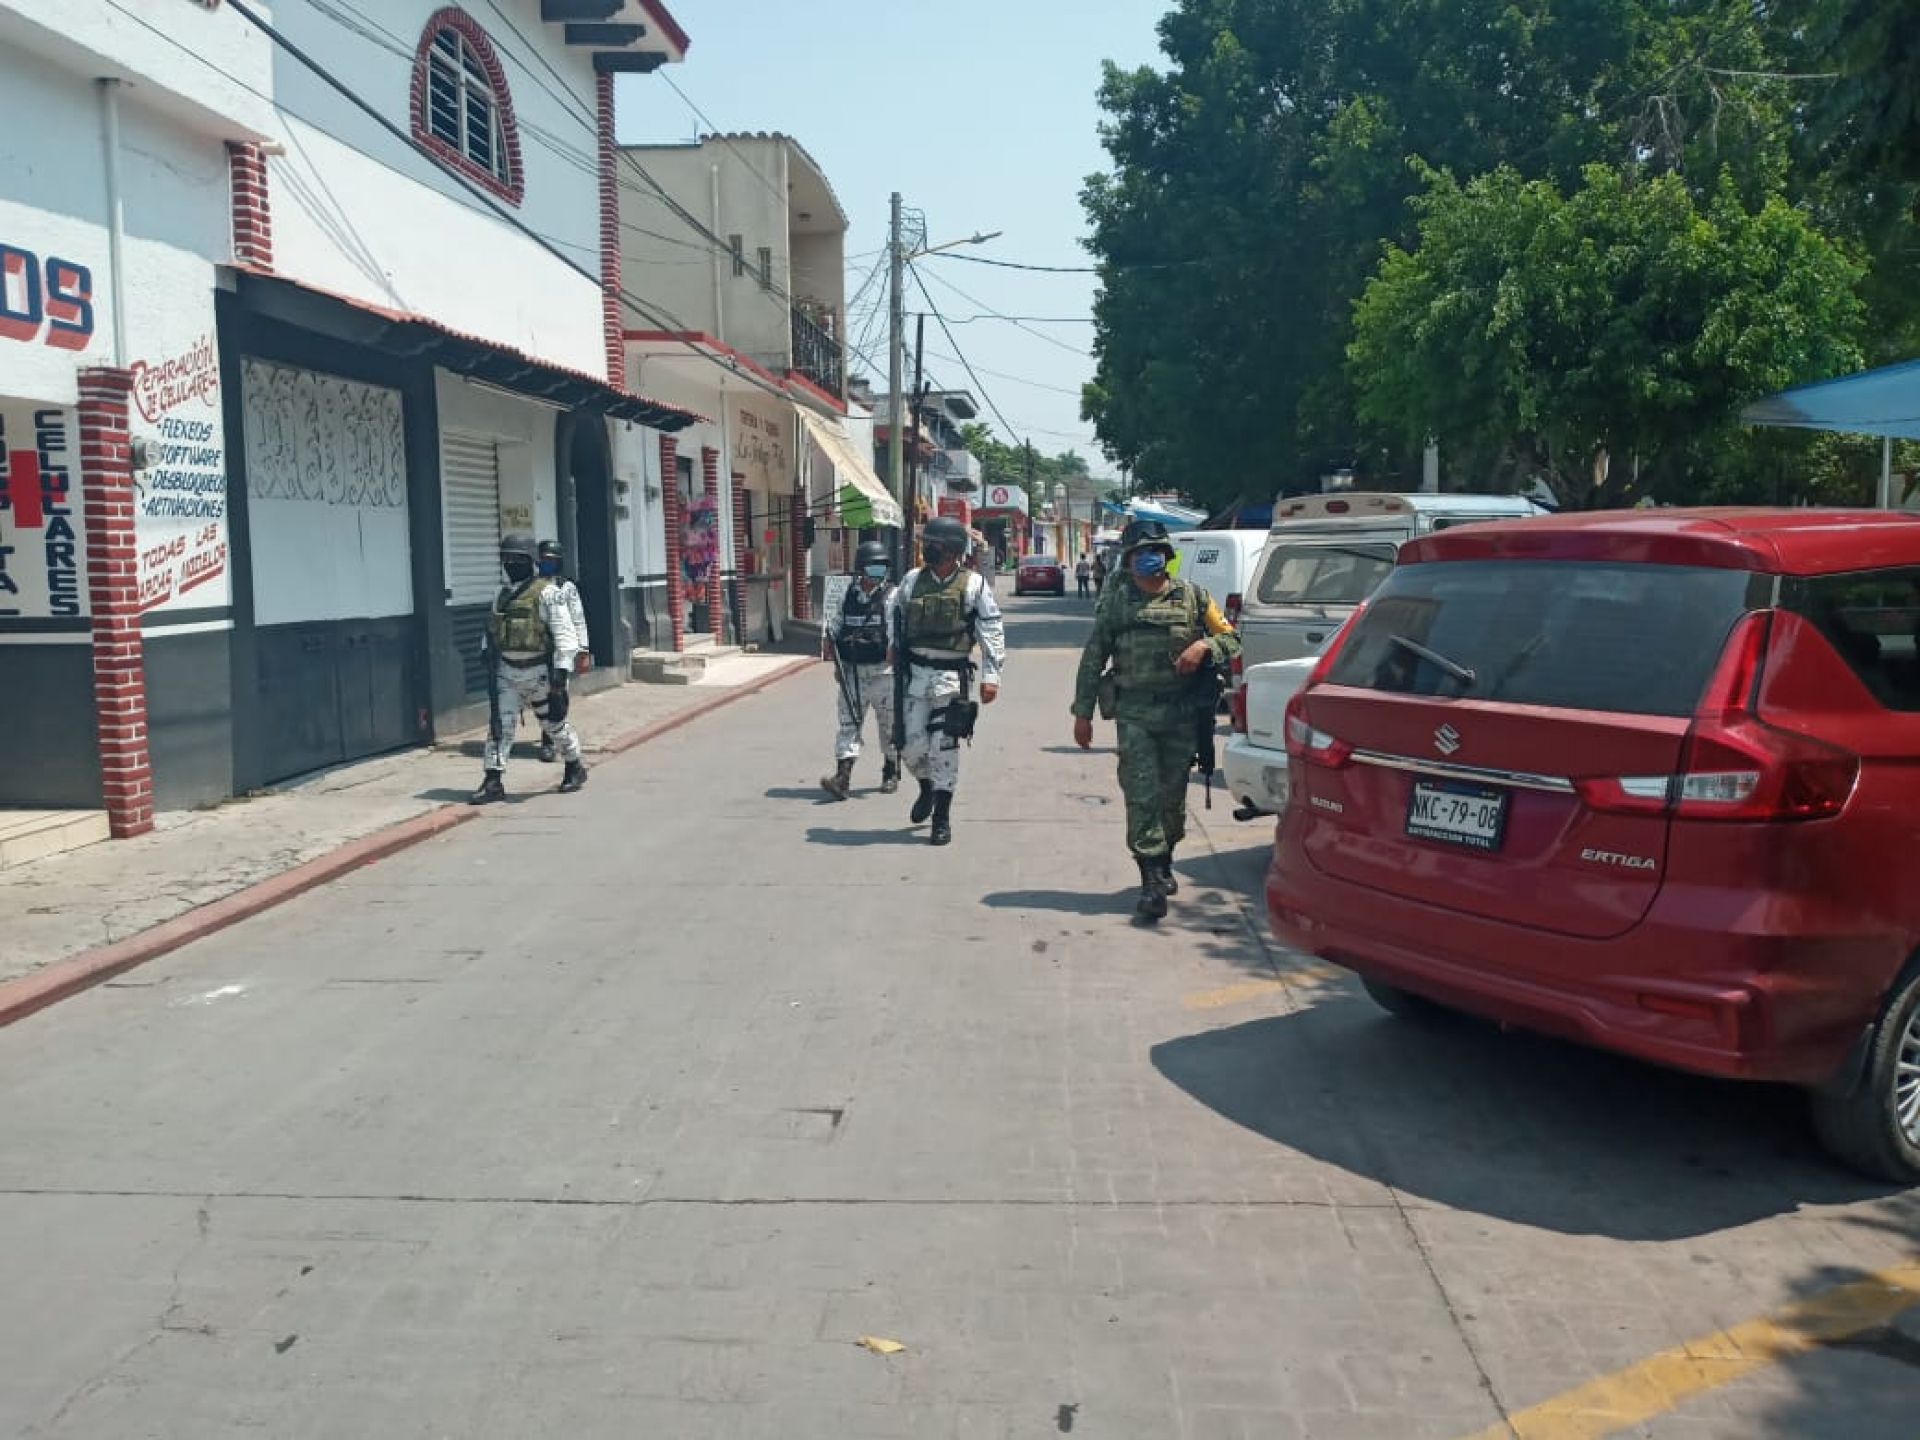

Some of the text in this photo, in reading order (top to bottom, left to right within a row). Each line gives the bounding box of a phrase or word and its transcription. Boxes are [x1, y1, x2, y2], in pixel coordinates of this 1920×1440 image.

[35, 410, 79, 616] CELULARES
[142, 535, 186, 573] TODAS
[137, 568, 172, 600] ARCAS
[1581, 848, 1655, 870] ERTIGA
